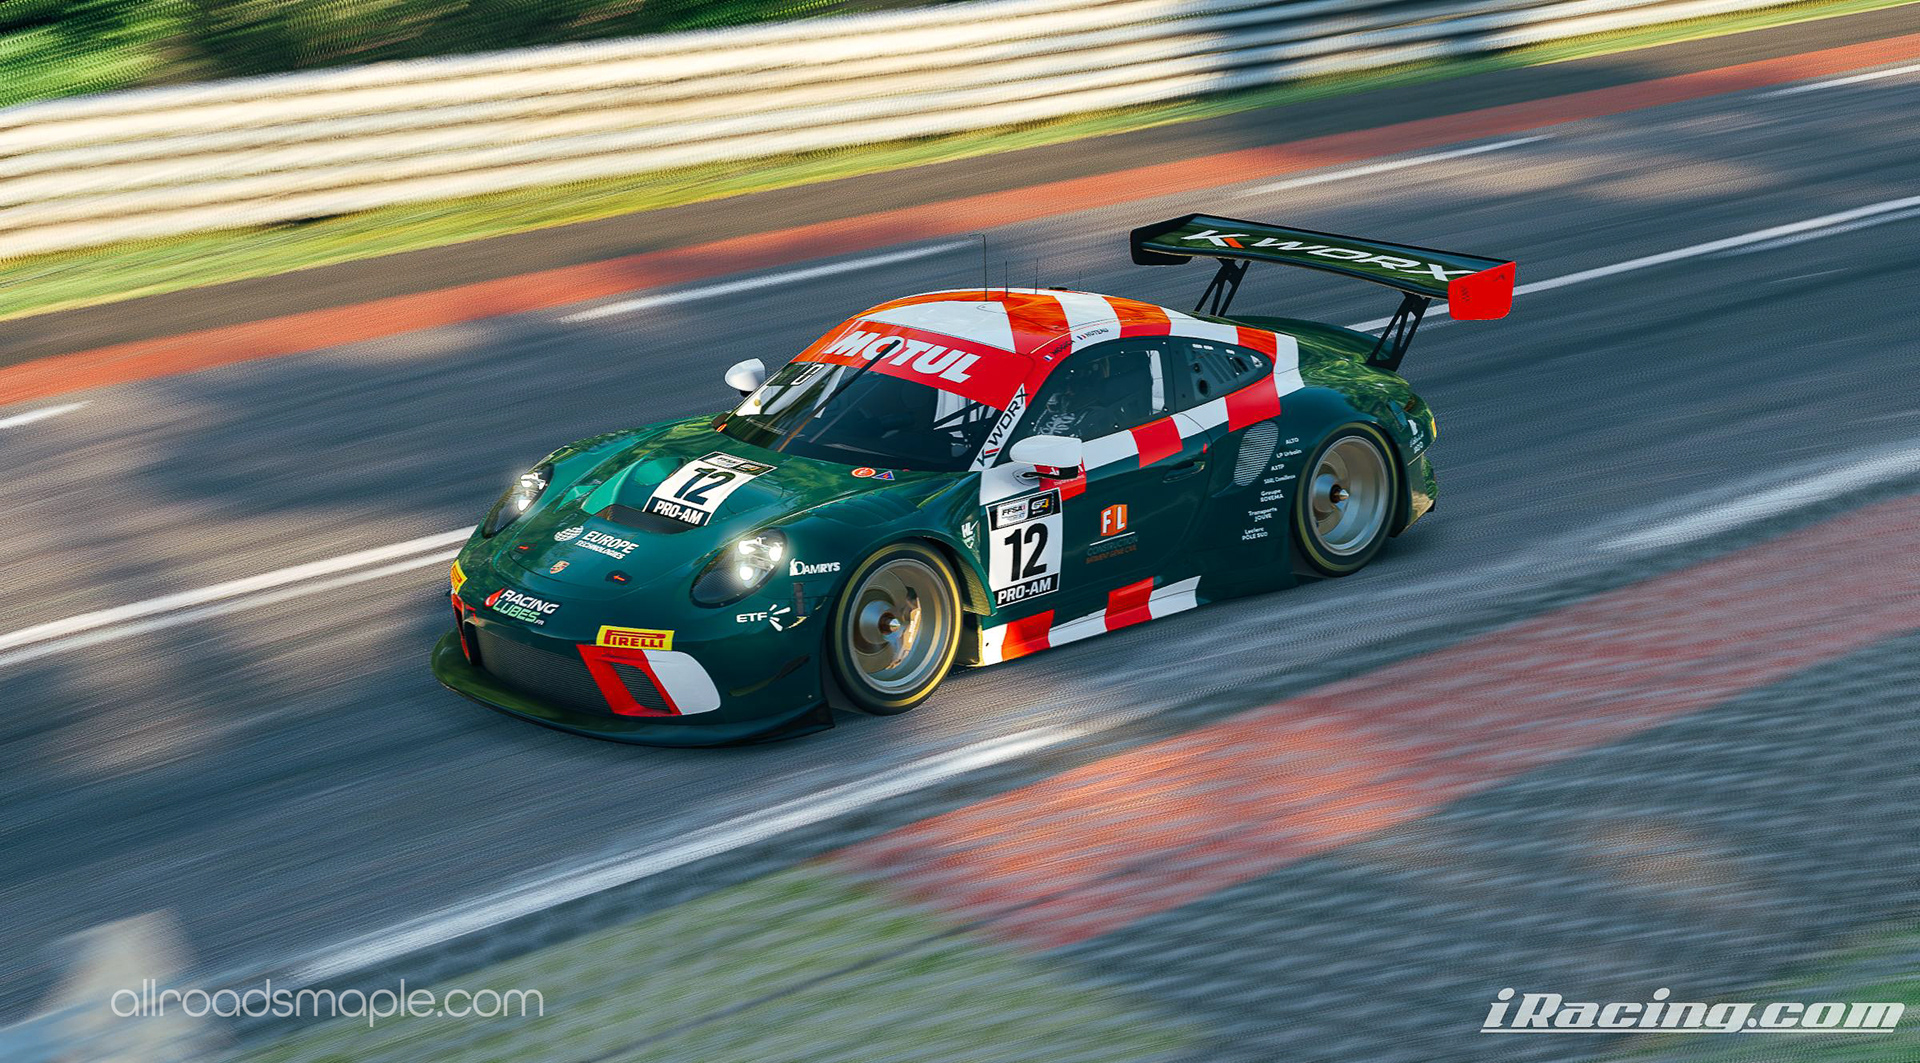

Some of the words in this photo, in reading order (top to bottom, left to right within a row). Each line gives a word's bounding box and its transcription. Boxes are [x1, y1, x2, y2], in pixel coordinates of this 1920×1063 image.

[823, 331, 982, 384] MOTUL
[673, 467, 736, 506] 12
[653, 500, 705, 525] PRO-AM
[574, 540, 626, 560] TECHNOLOGIES
[582, 530, 640, 554] EUROPE
[1004, 523, 1048, 582] 12
[500, 589, 560, 615] RACING
[997, 577, 1052, 605] PRO-AM
[736, 611, 768, 623] ETF
[603, 629, 667, 648] PIRELLI
